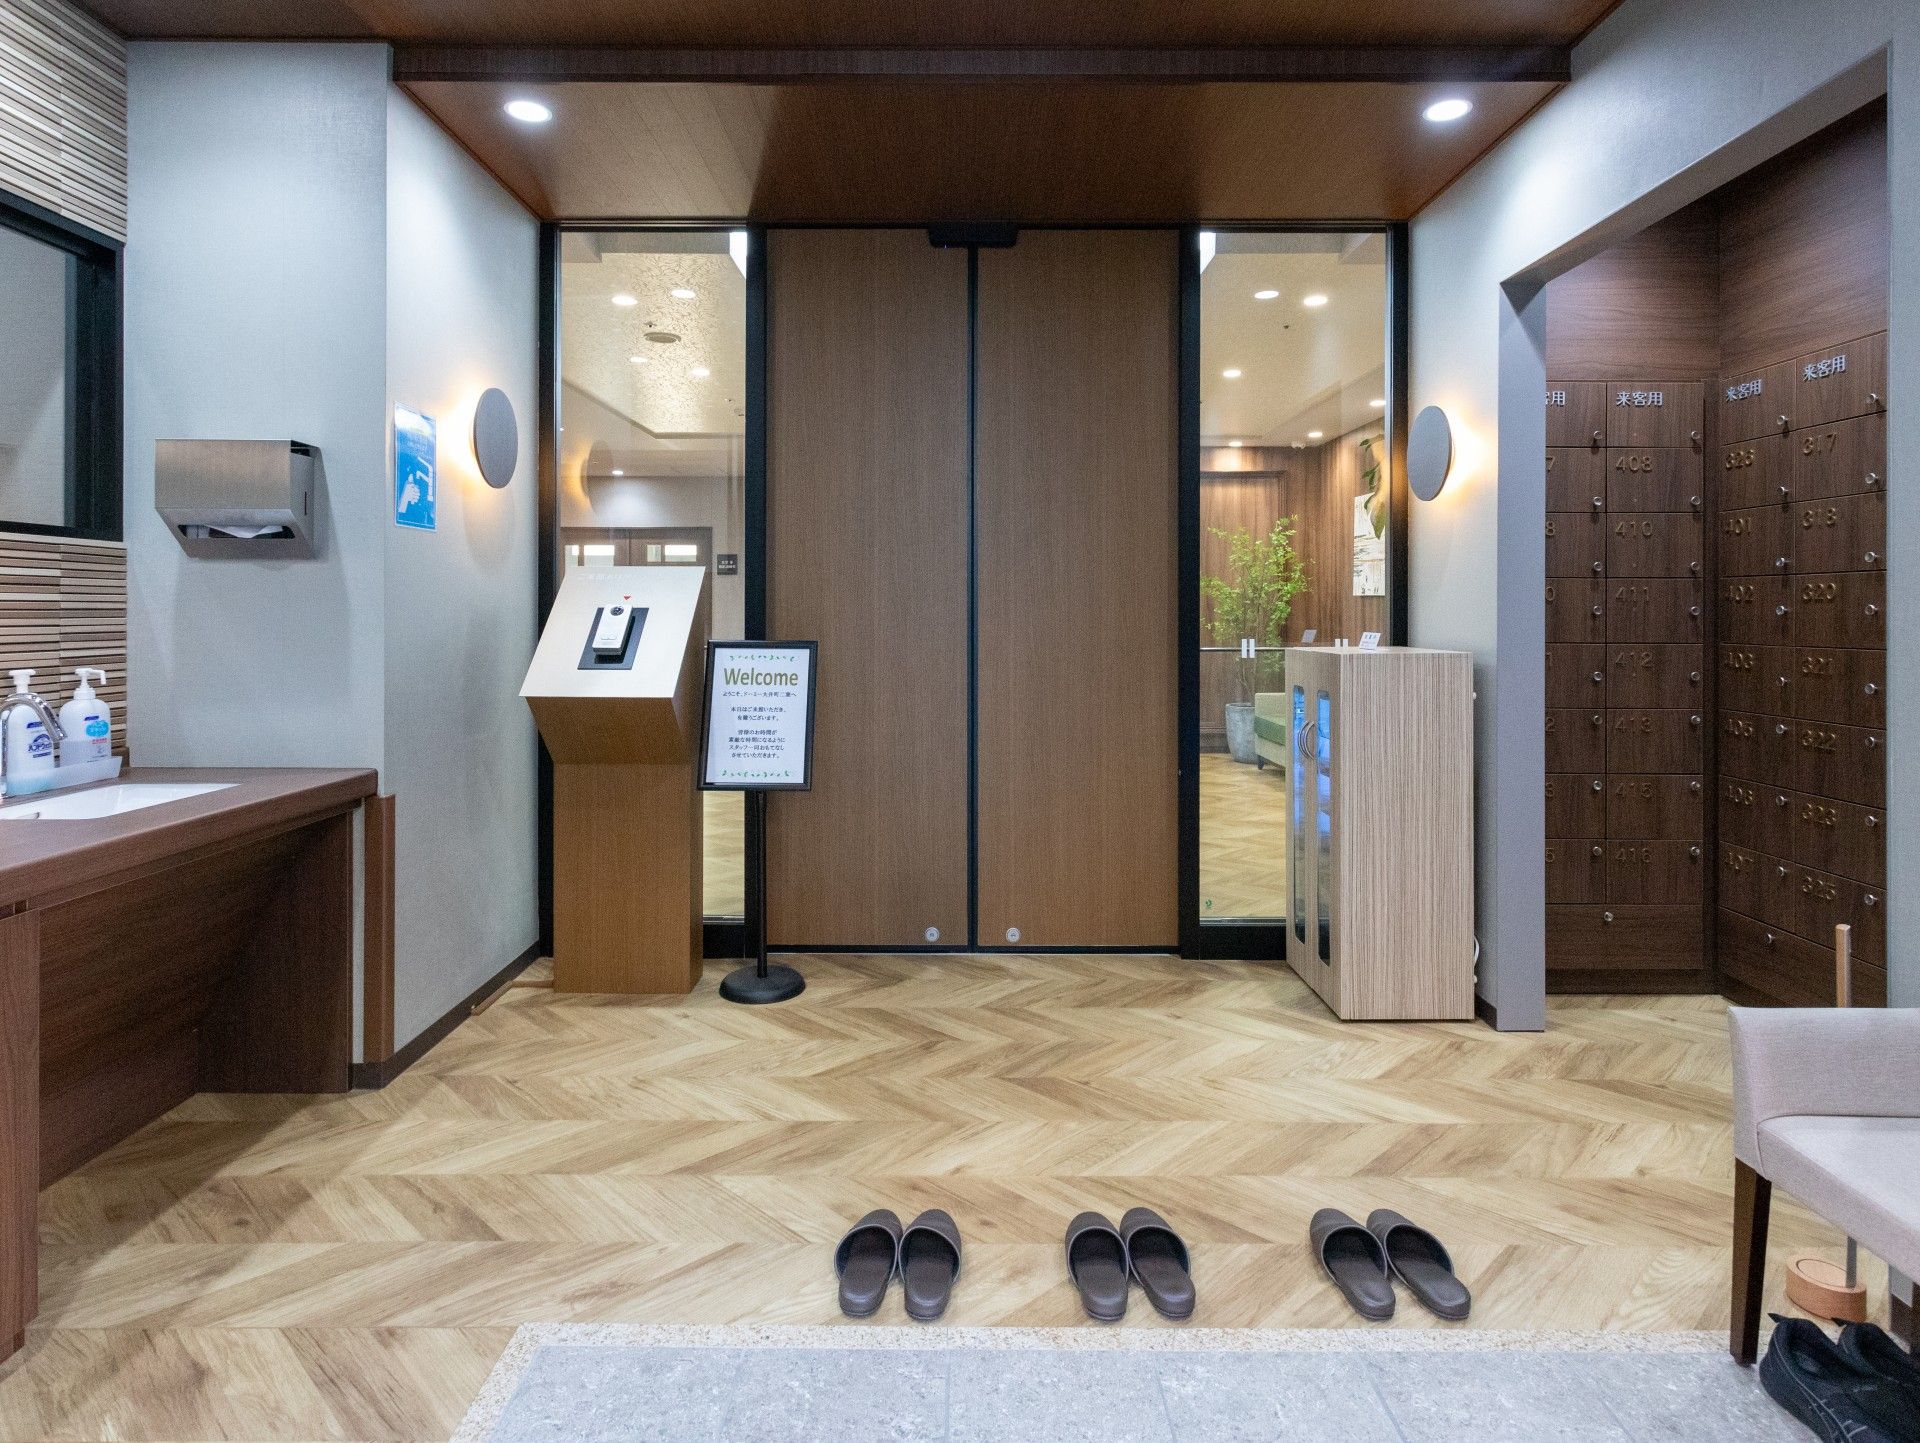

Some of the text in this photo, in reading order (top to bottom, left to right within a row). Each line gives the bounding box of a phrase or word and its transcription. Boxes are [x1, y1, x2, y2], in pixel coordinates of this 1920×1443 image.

[1803, 354, 1847, 381] 来客用
[1616, 391, 1664, 407] 来客用
[1725, 378, 1763, 402] 来客用
[1802, 433, 1838, 455] 317
[1615, 455, 1653, 473] 408
[1615, 520, 1654, 538] 410
[1615, 586, 1651, 603] 411
[1615, 651, 1654, 668] 412
[724, 667, 799, 686] Welcome
